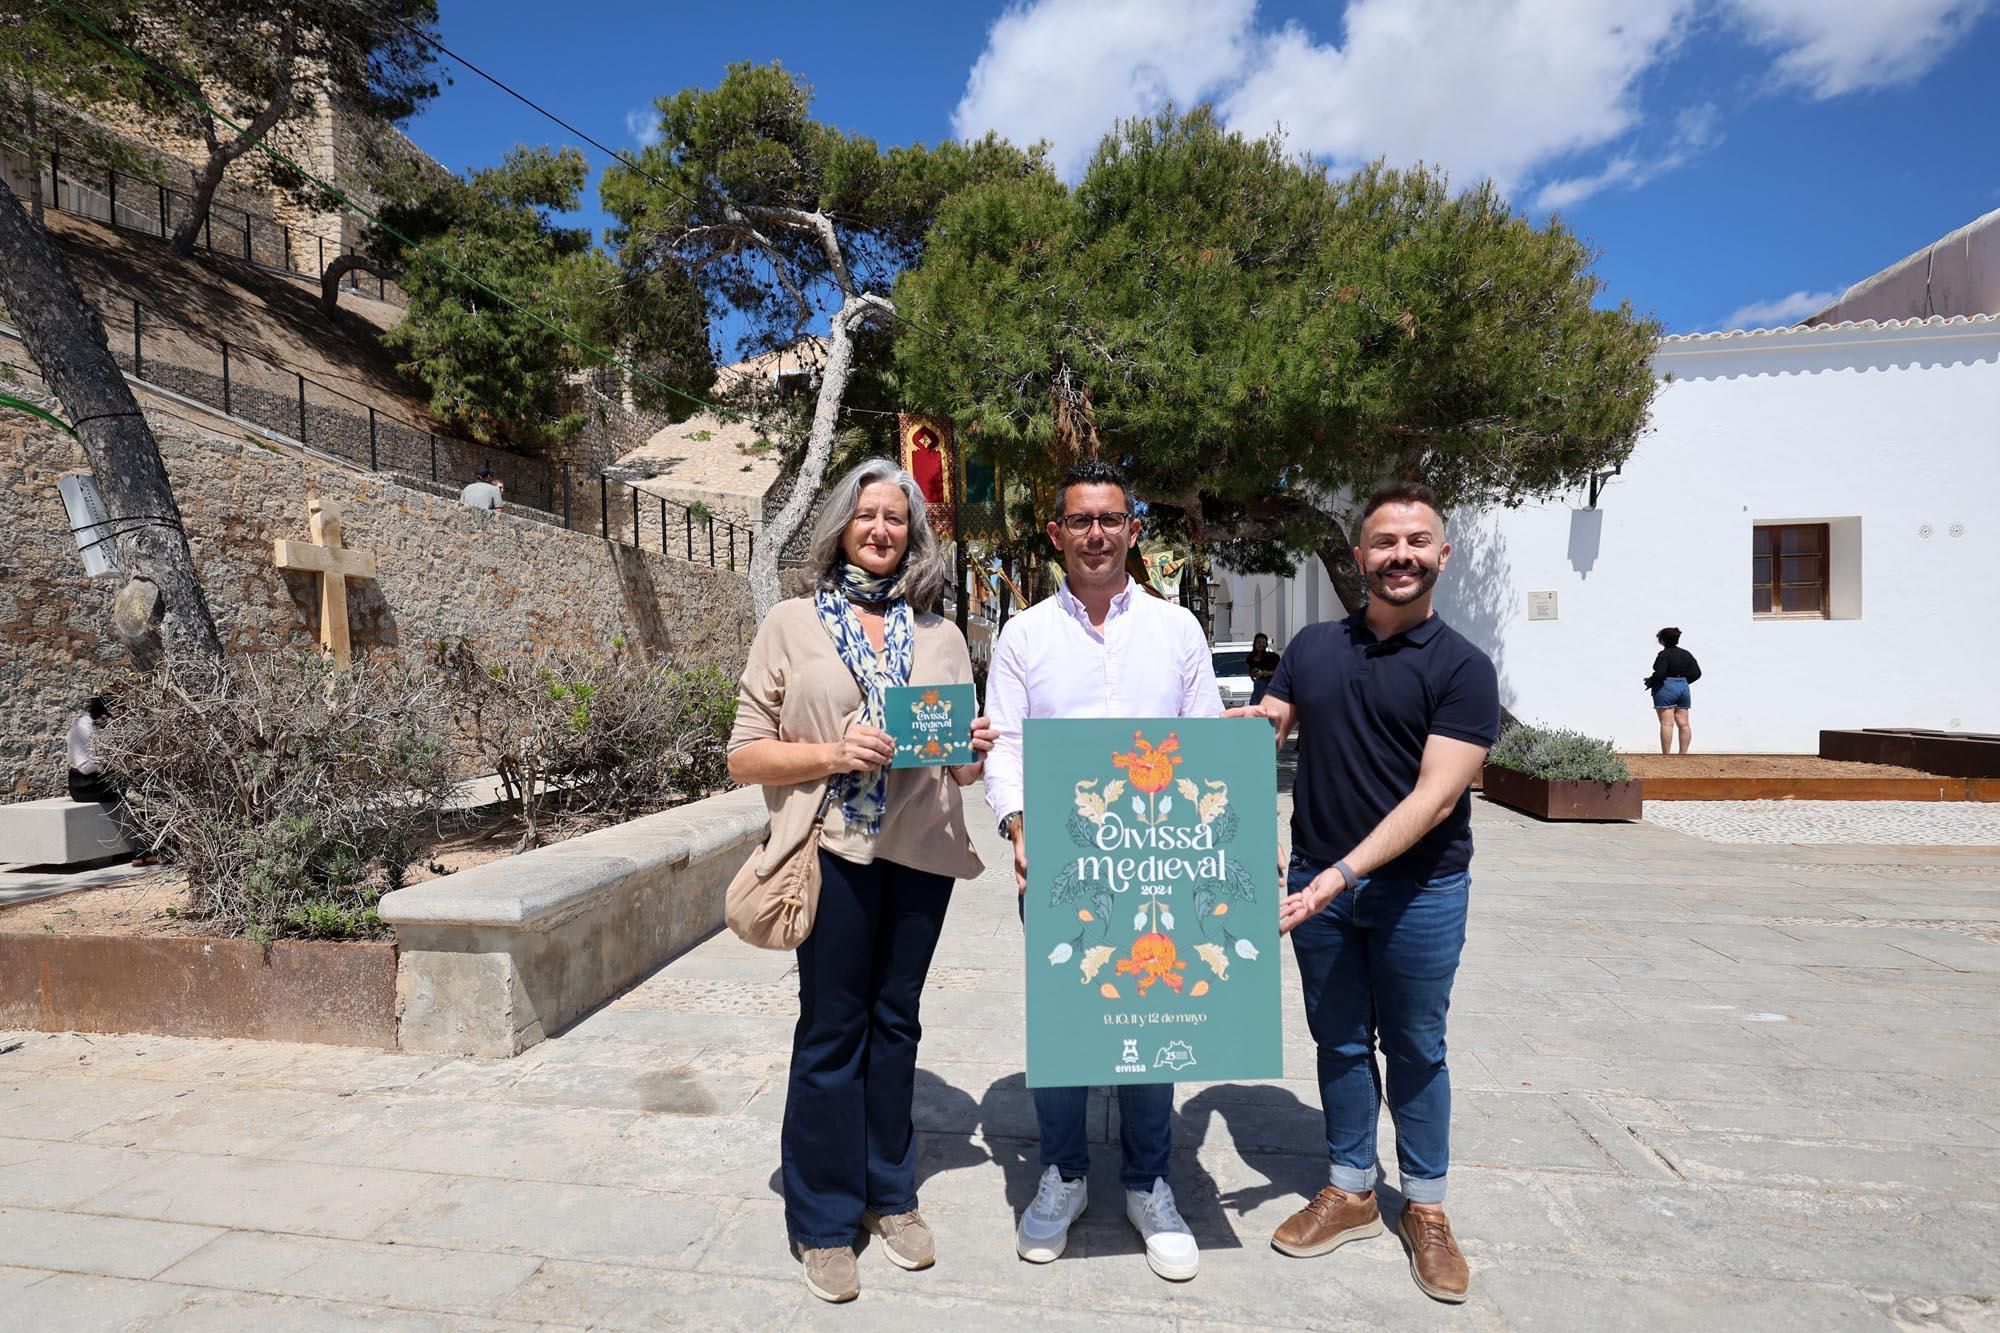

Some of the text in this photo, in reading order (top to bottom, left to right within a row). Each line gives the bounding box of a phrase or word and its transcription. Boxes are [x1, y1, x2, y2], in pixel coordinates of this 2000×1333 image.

[1077, 849, 1226, 892] medieval
[1140, 885, 1173, 896] 2024
[1138, 1015, 1147, 1027] y
[1148, 1012, 1160, 1024] 12
[1161, 1012, 1175, 1024] de
[1176, 1013, 1207, 1025] mayo
[1165, 1051, 1176, 1060] 25
[1115, 1064, 1146, 1072] eivissa
